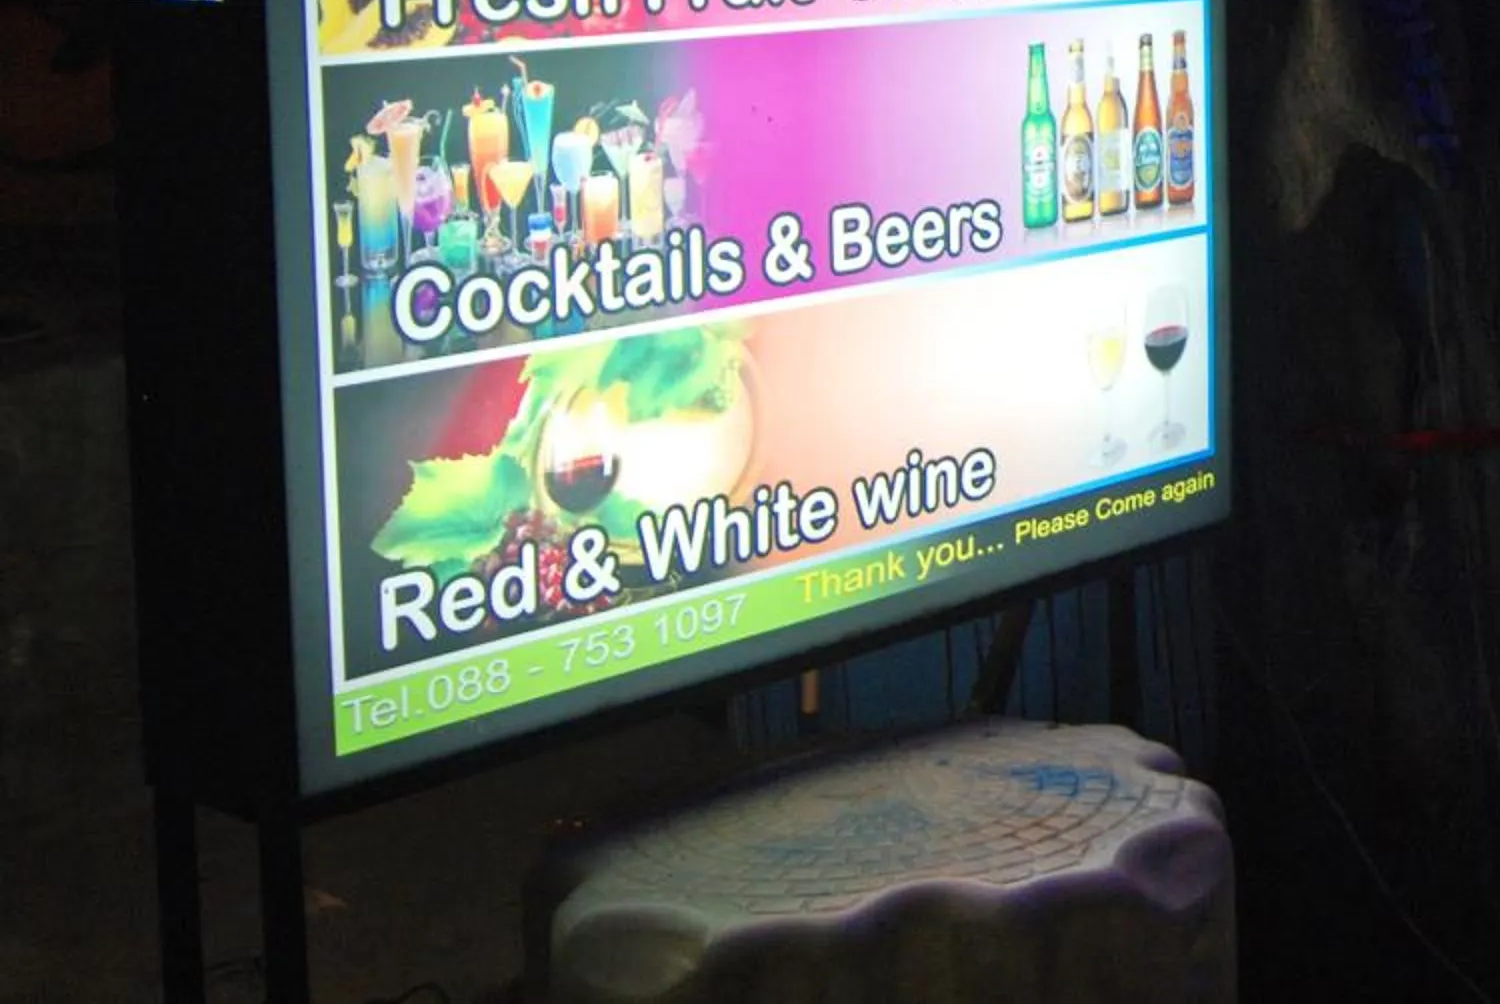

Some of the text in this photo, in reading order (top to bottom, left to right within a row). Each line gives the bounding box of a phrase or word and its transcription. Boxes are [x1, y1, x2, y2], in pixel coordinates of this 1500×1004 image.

[394, 198, 1003, 342] Cocktails & Beers
[379, 446, 997, 652] Red & White wine
[800, 470, 1216, 603] Thank you... Please Come again
[560, 622, 635, 674] 753
[653, 594, 747, 645] 1097
